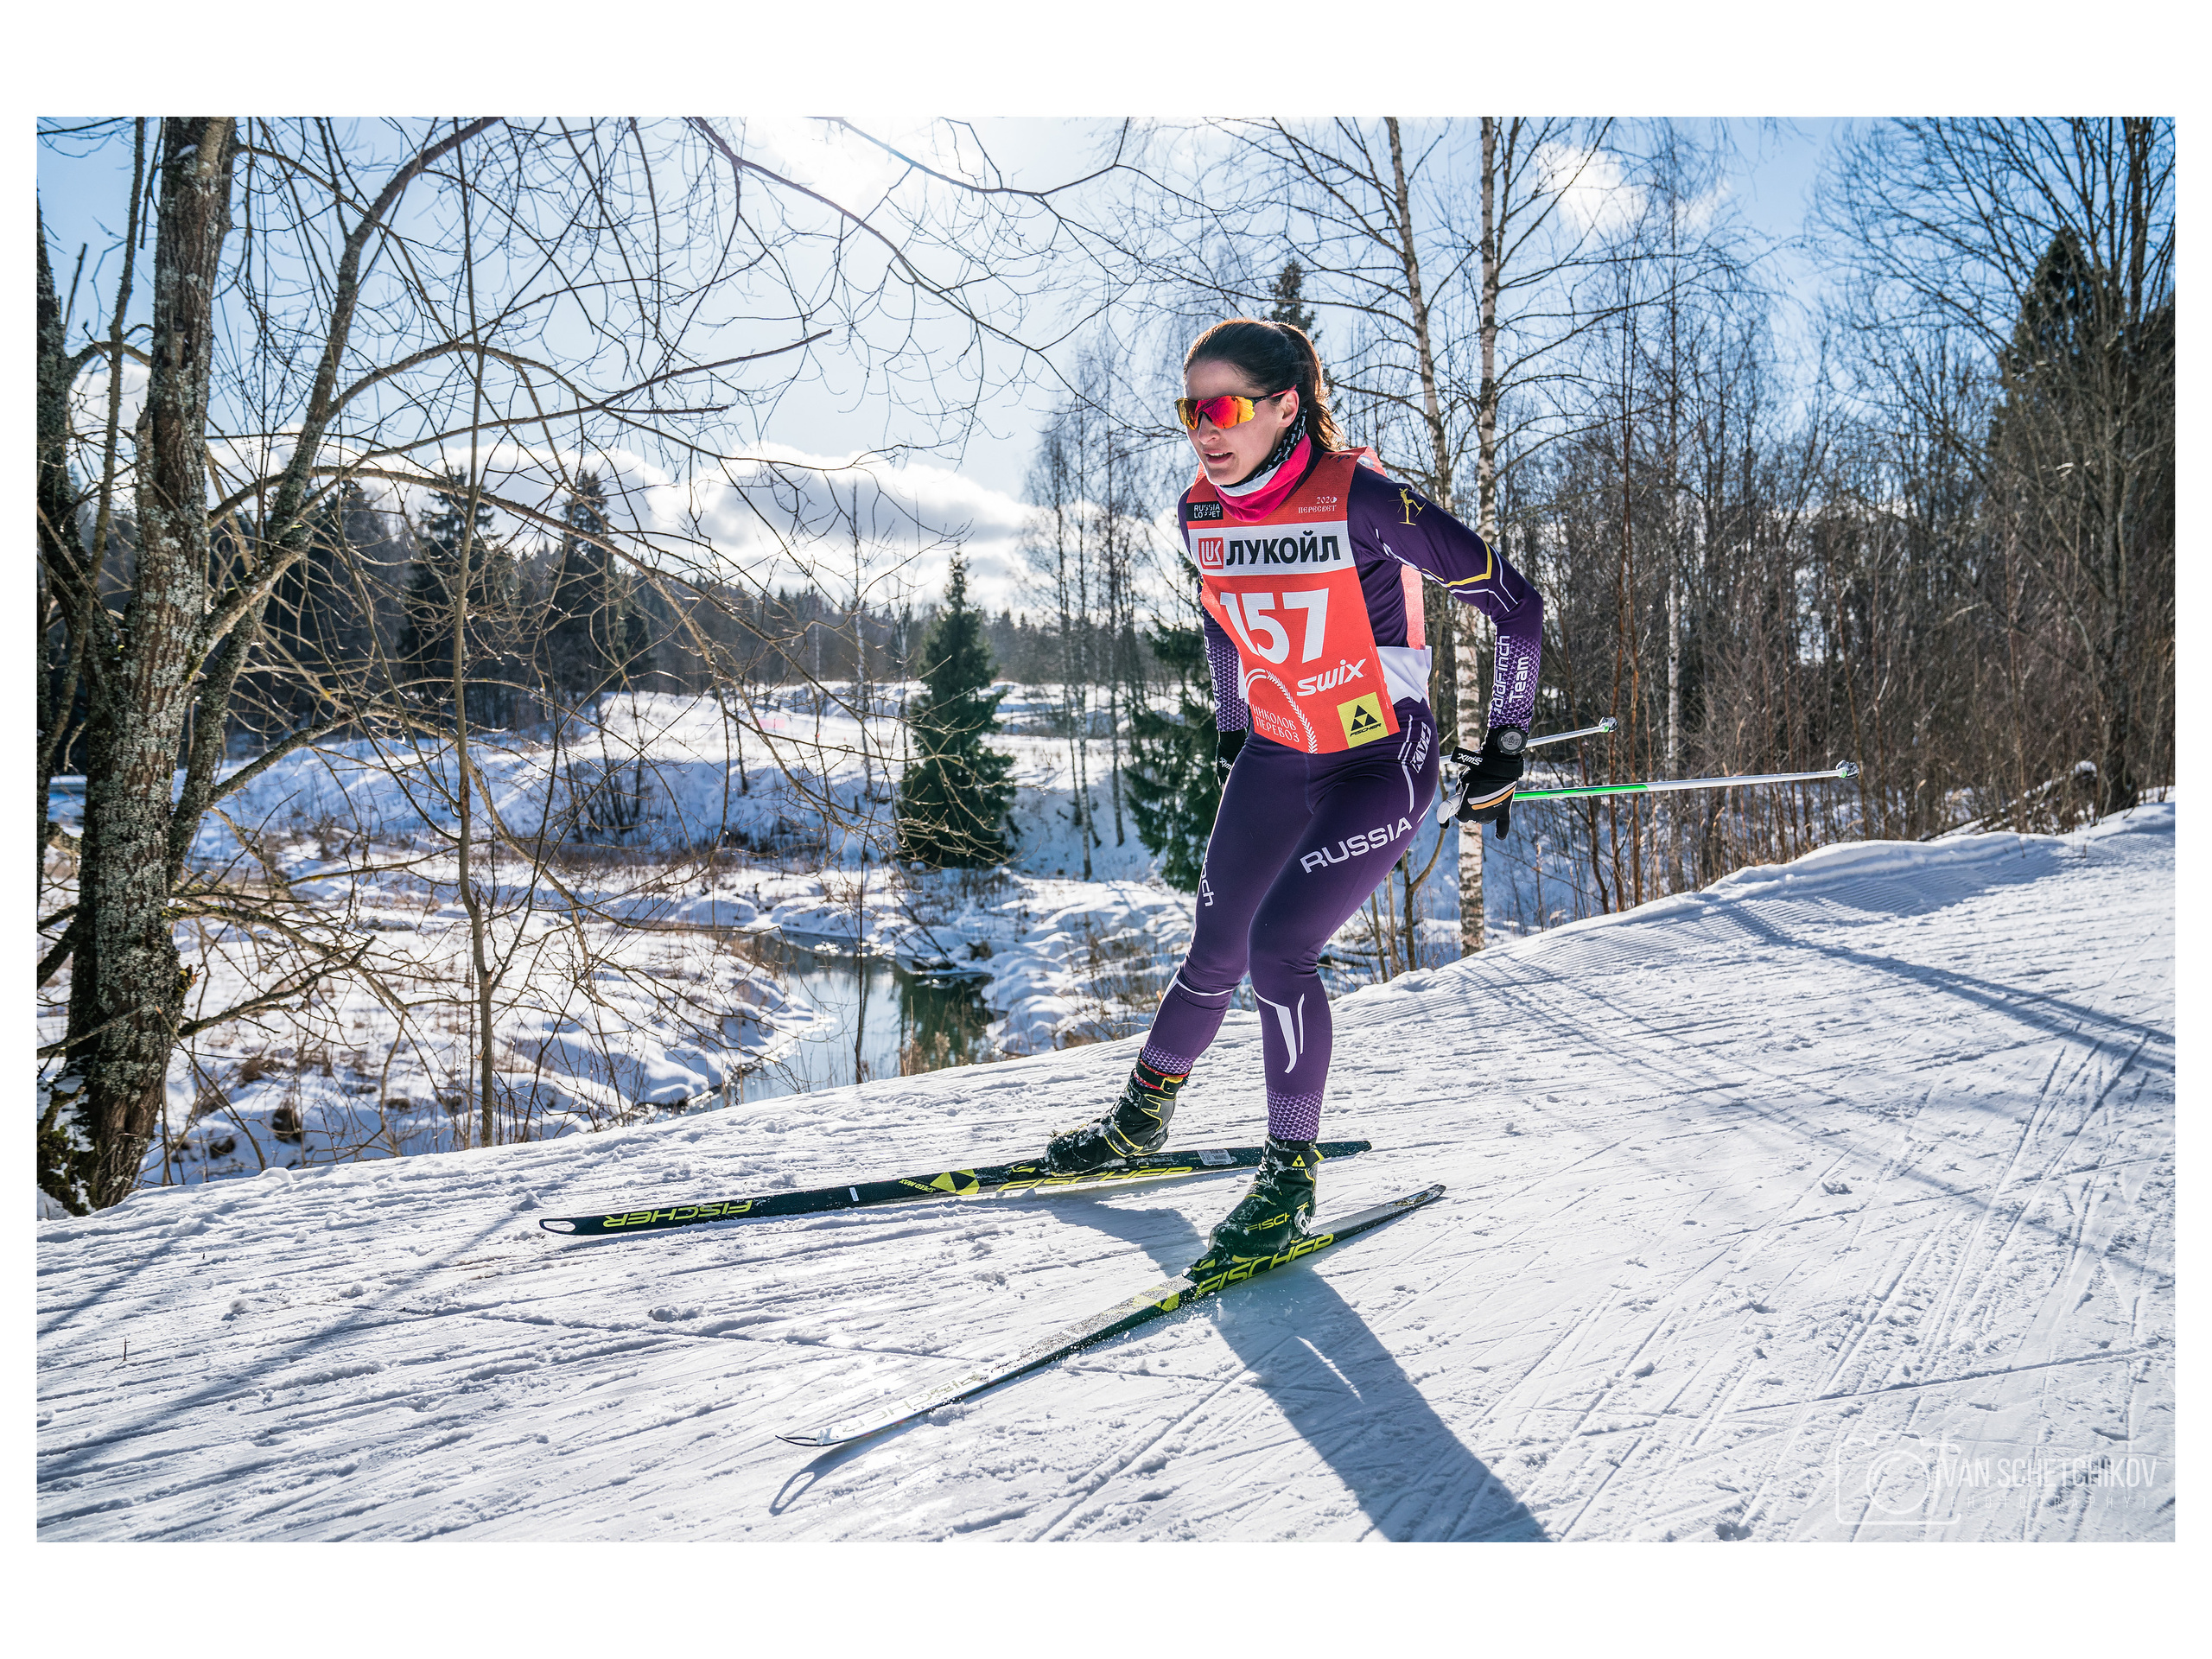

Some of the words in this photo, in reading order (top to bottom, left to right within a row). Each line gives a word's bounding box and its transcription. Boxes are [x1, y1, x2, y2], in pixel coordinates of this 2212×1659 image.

[1193, 503, 1221, 512] RUSSIA
[1226, 530, 1342, 566] ЛУКОЙЛ
[1219, 588, 1330, 664] 157
[1509, 655, 1529, 703] Team
[1255, 715, 1300, 743] ПЕРЕВОЗ
[1350, 722, 1382, 737] FISCHER
[1299, 817, 1413, 874] RUSSIA
[602, 1199, 753, 1228] FISCHER
